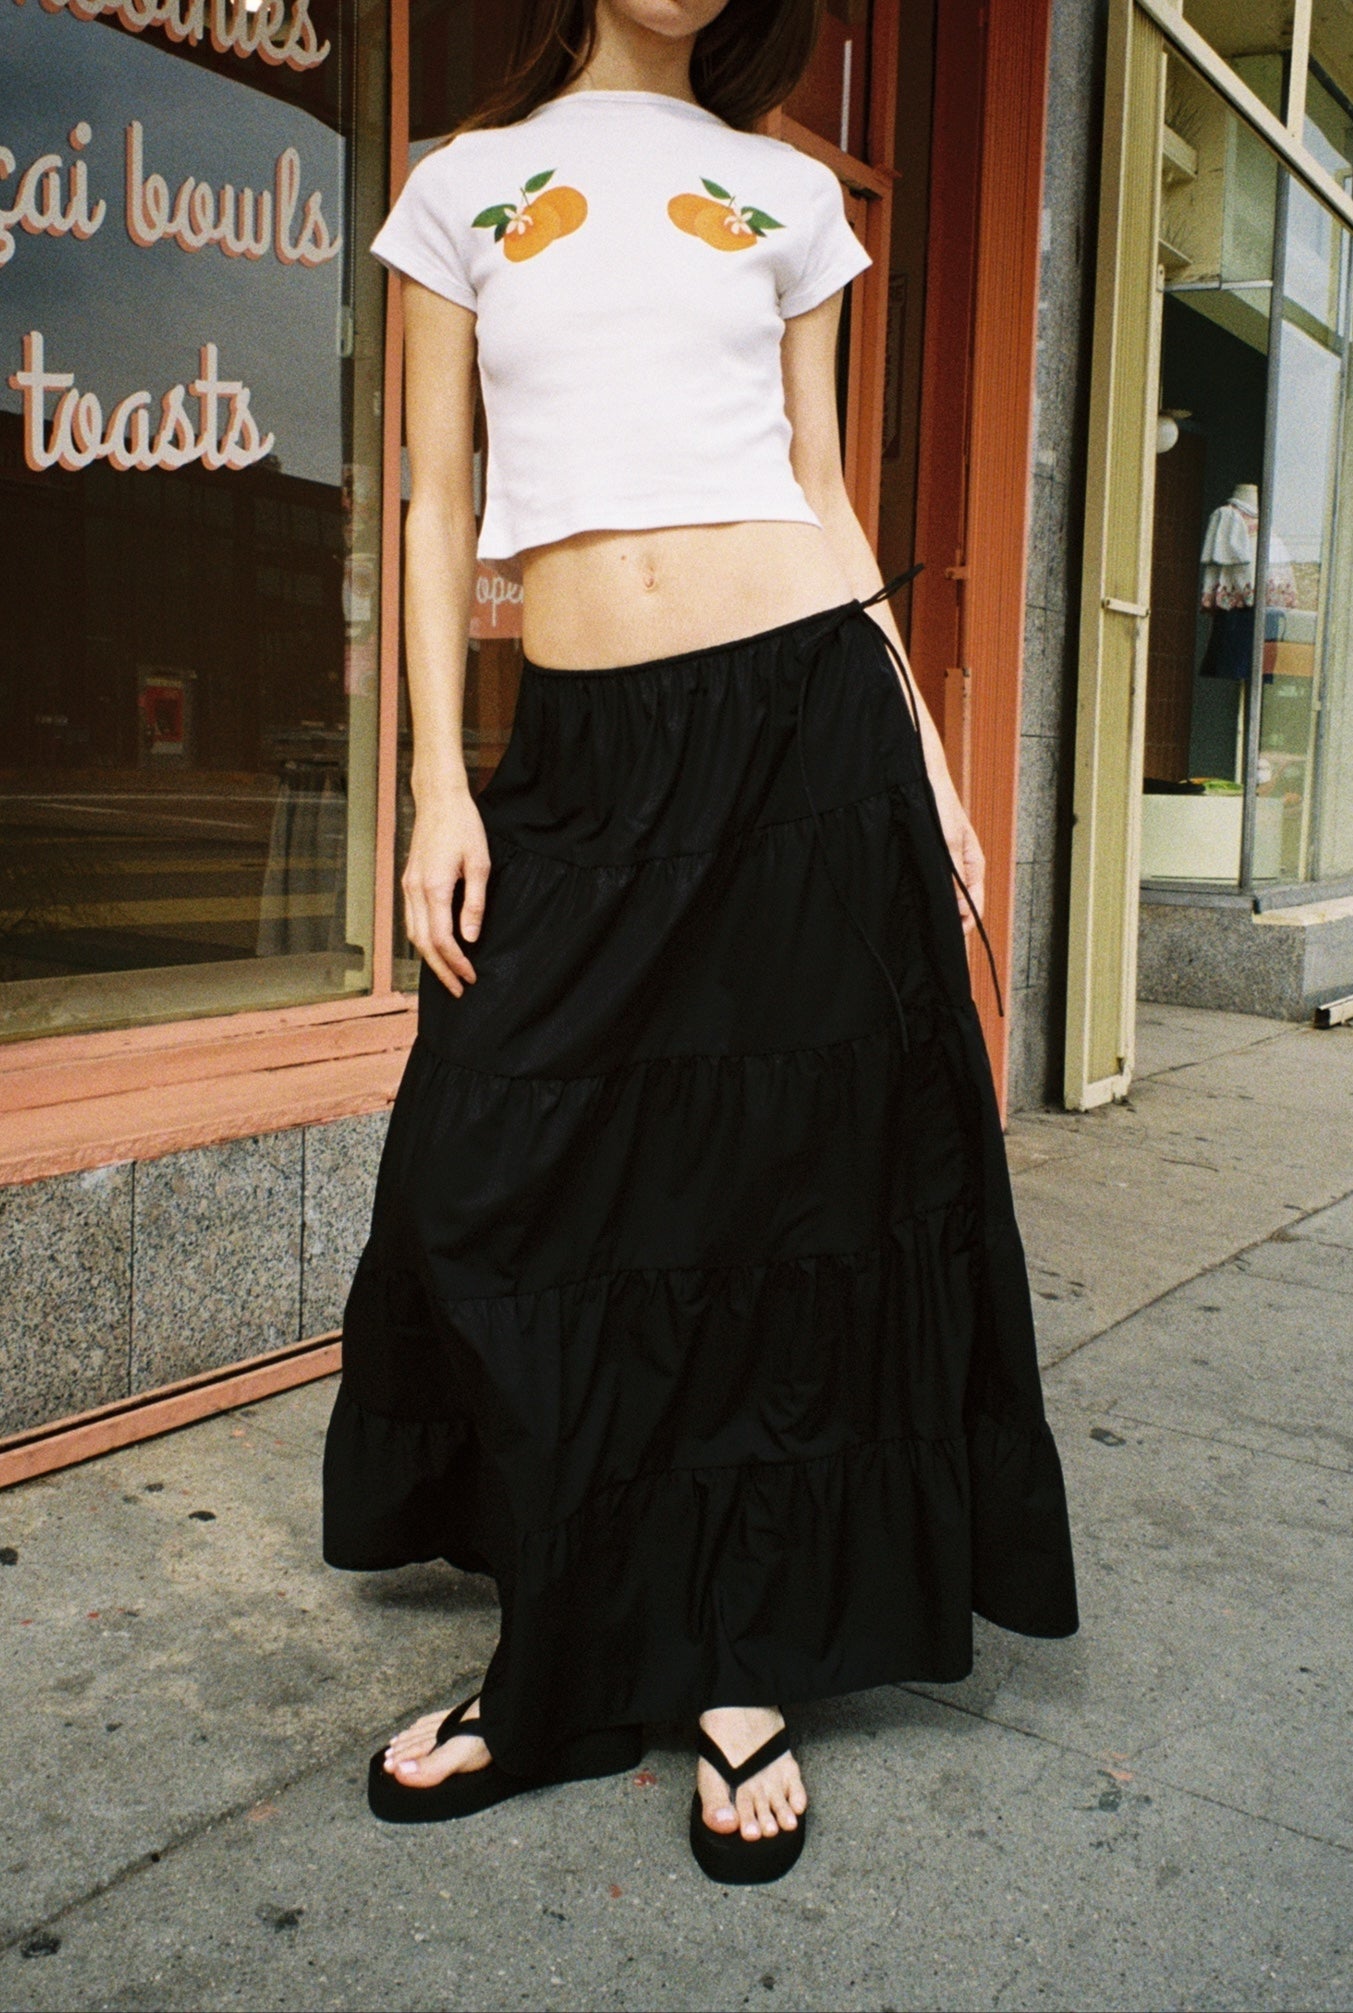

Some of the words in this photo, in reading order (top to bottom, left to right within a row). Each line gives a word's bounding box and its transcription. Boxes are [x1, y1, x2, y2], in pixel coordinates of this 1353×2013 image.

[126, 120, 342, 267] bowls
[9, 331, 275, 471] toasts
[476, 576, 524, 628] ope
